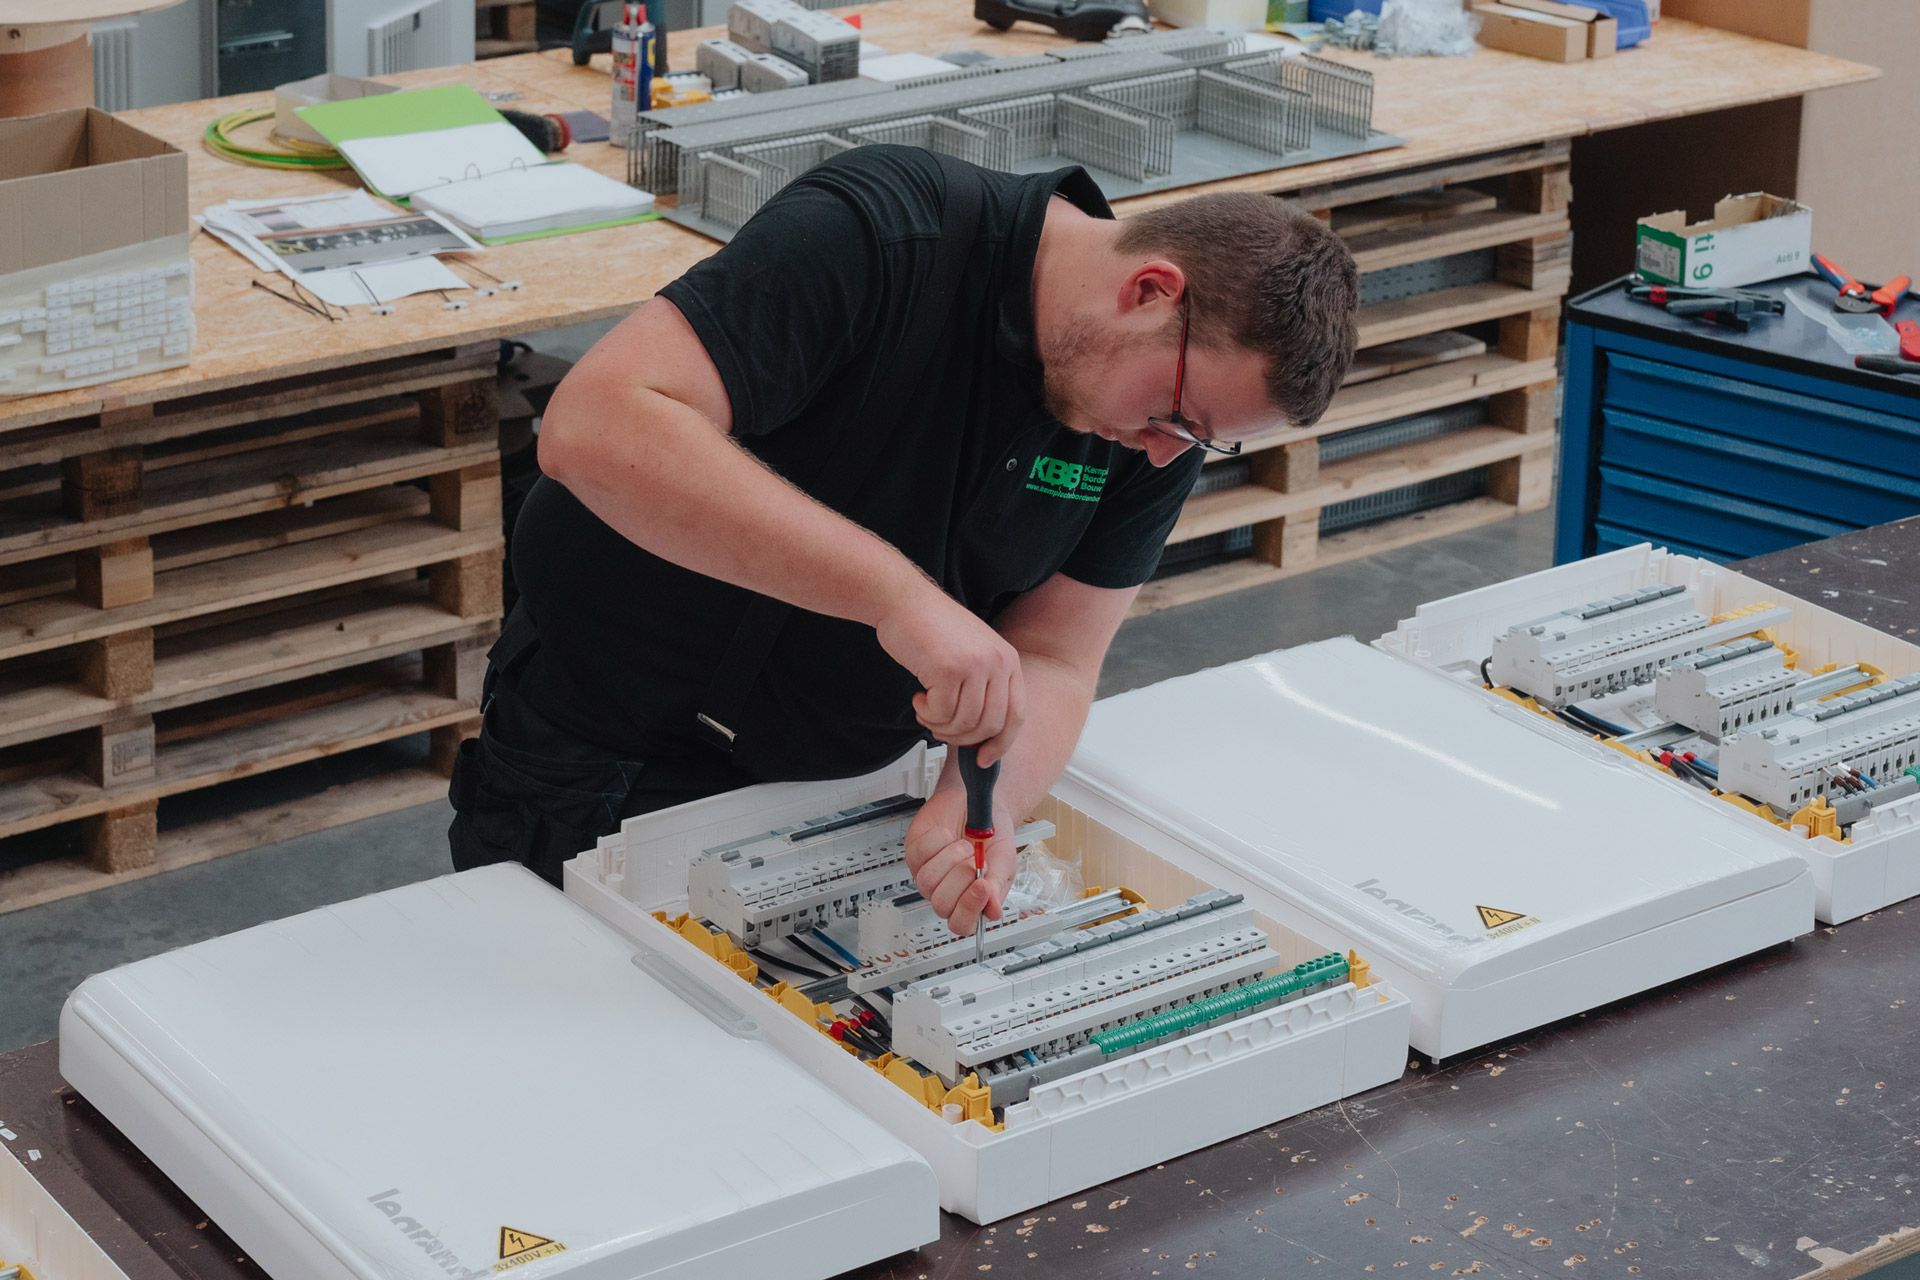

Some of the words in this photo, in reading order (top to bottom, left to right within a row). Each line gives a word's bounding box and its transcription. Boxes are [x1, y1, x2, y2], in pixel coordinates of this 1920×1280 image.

[1692, 263, 1713, 281] 9
[1029, 455, 1083, 488] KBB
[554, 1243, 566, 1251] N
